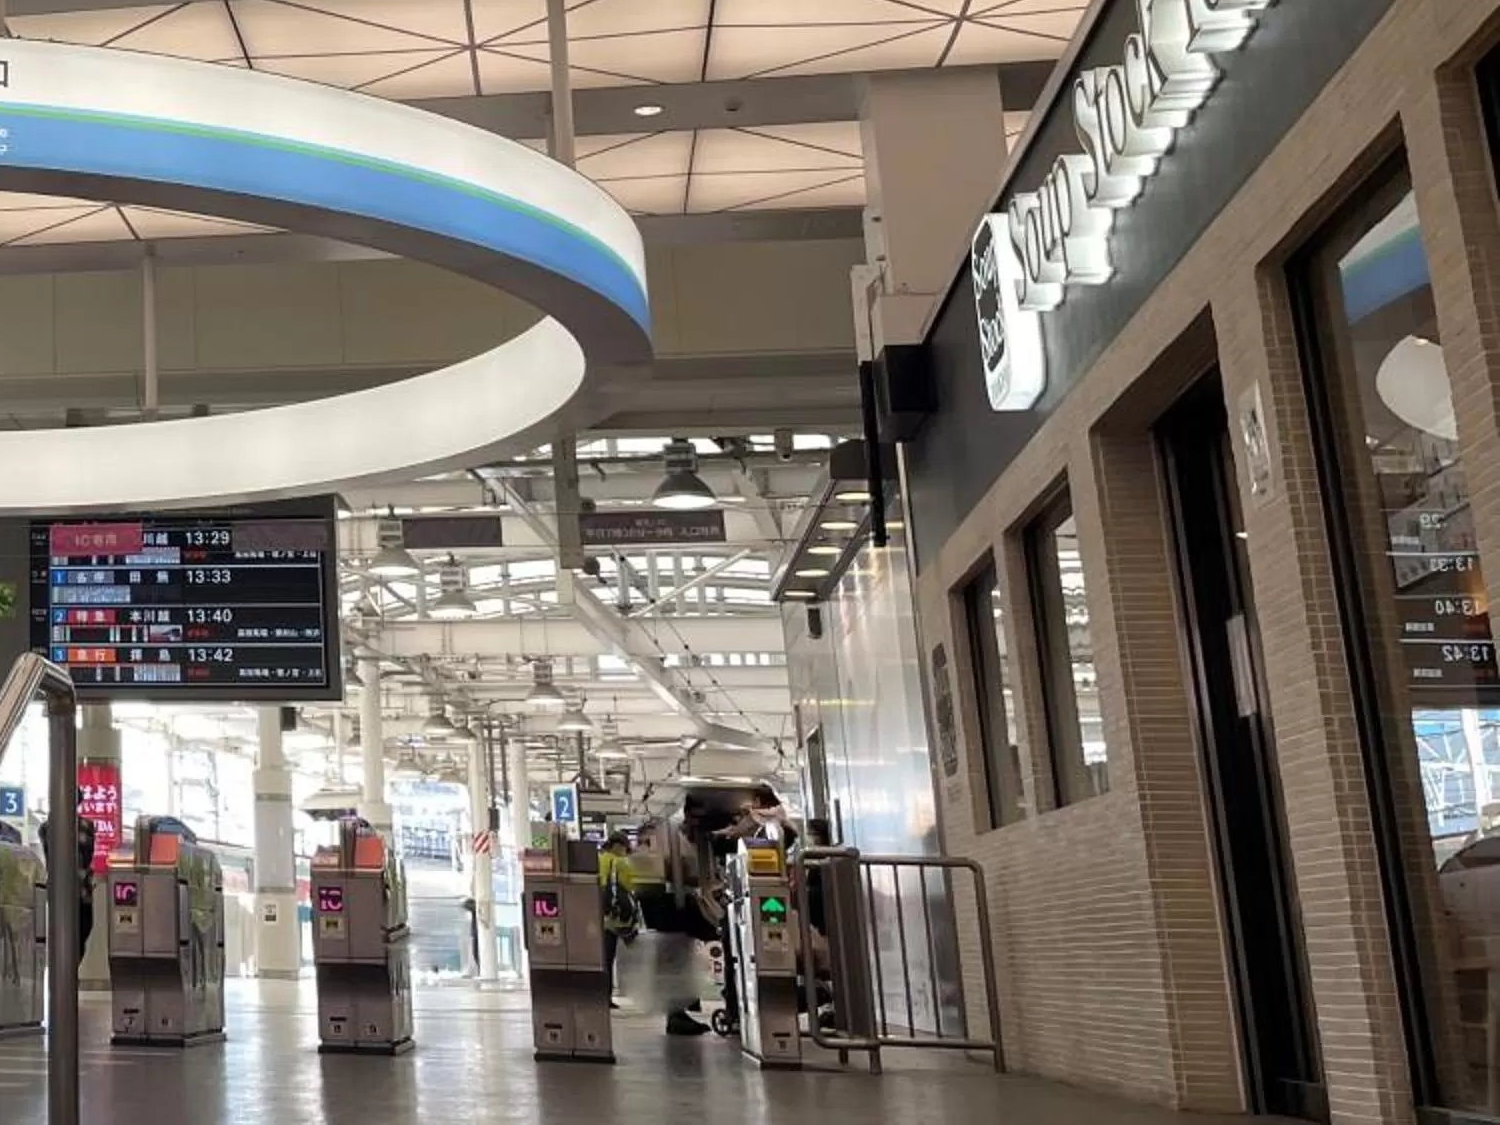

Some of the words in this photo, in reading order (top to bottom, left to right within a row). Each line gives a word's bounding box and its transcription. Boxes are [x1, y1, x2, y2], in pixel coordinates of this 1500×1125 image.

[185, 530, 230, 545] 13:29
[186, 569, 232, 584] 13:33
[187, 608, 233, 623] 13:40
[188, 648, 234, 662] 13:42
[5, 792, 17, 812] 3
[558, 796, 571, 818] 2
